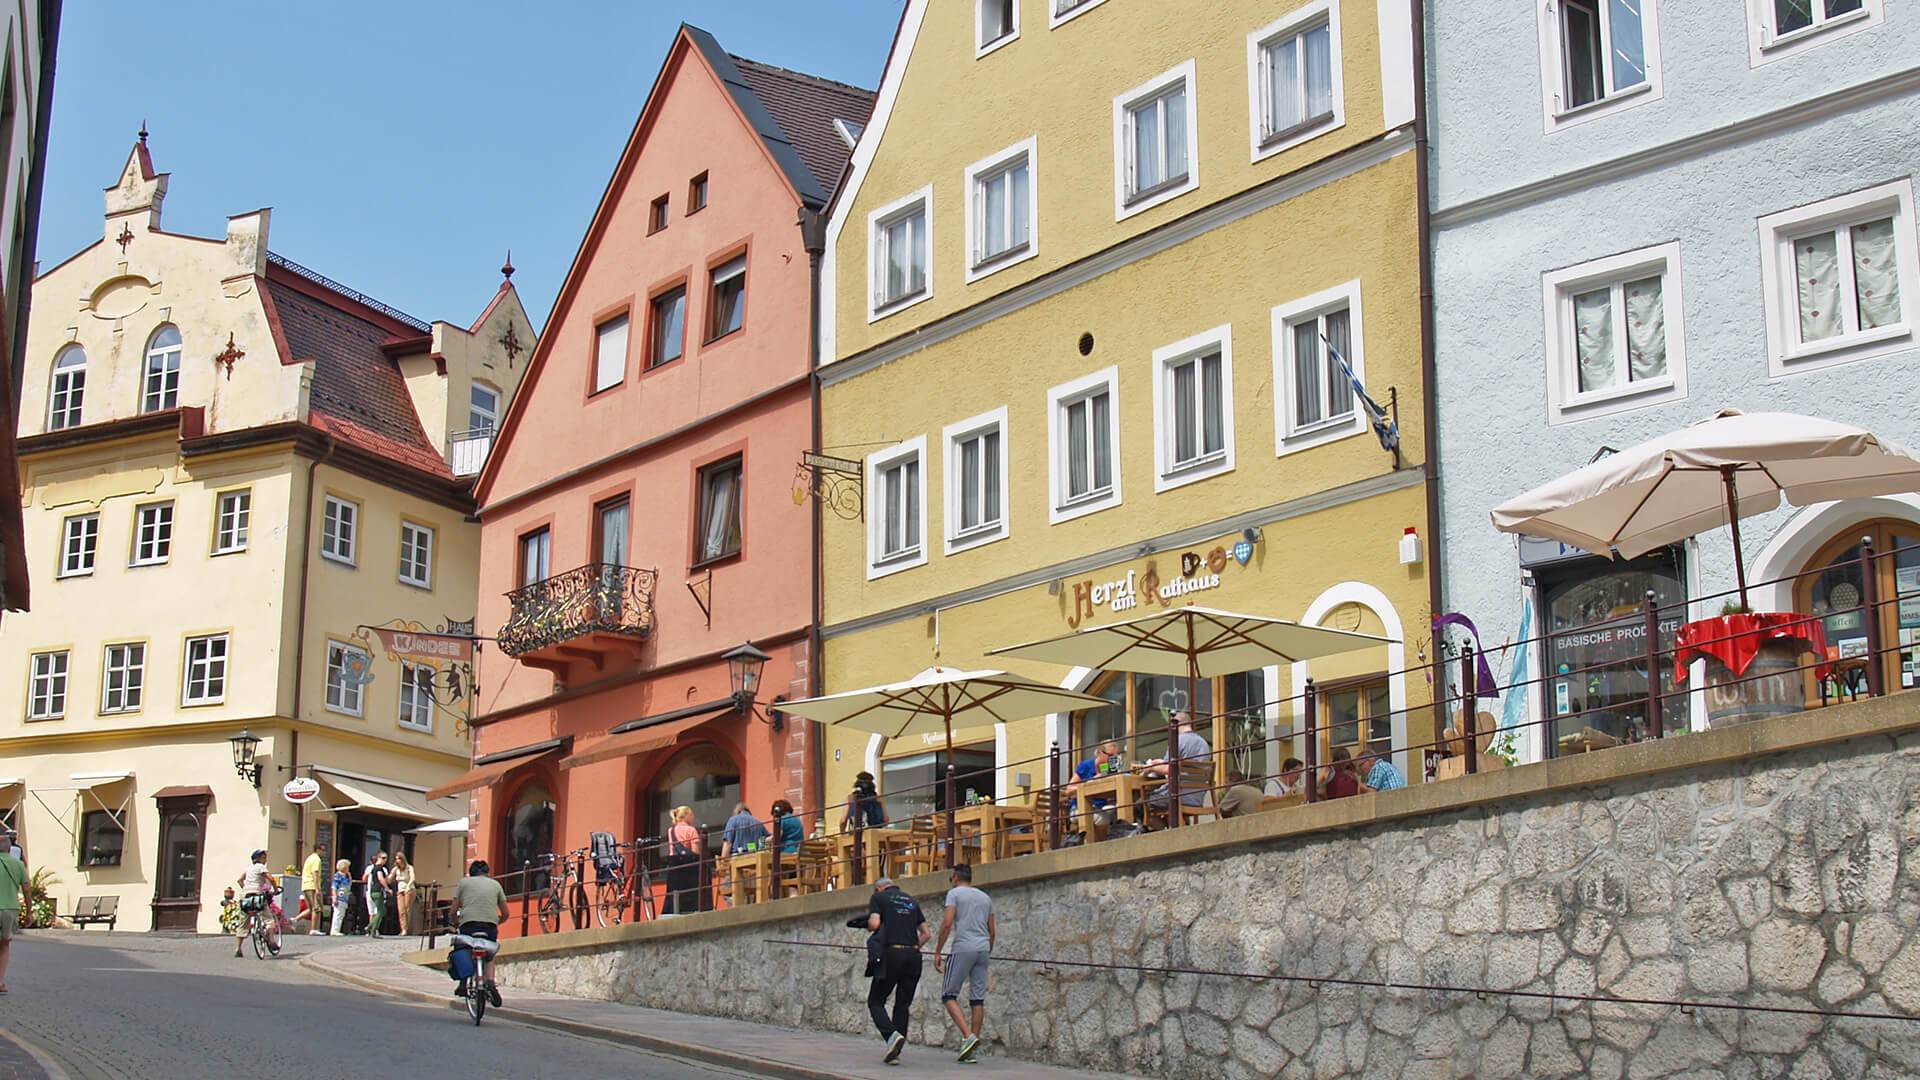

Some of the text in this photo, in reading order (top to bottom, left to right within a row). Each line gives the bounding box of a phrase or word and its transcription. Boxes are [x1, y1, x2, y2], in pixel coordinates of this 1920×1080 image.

[1068, 569, 1220, 628] Herzl am Rathaus
[1558, 620, 1678, 649] BASISCHE PRODKTE
